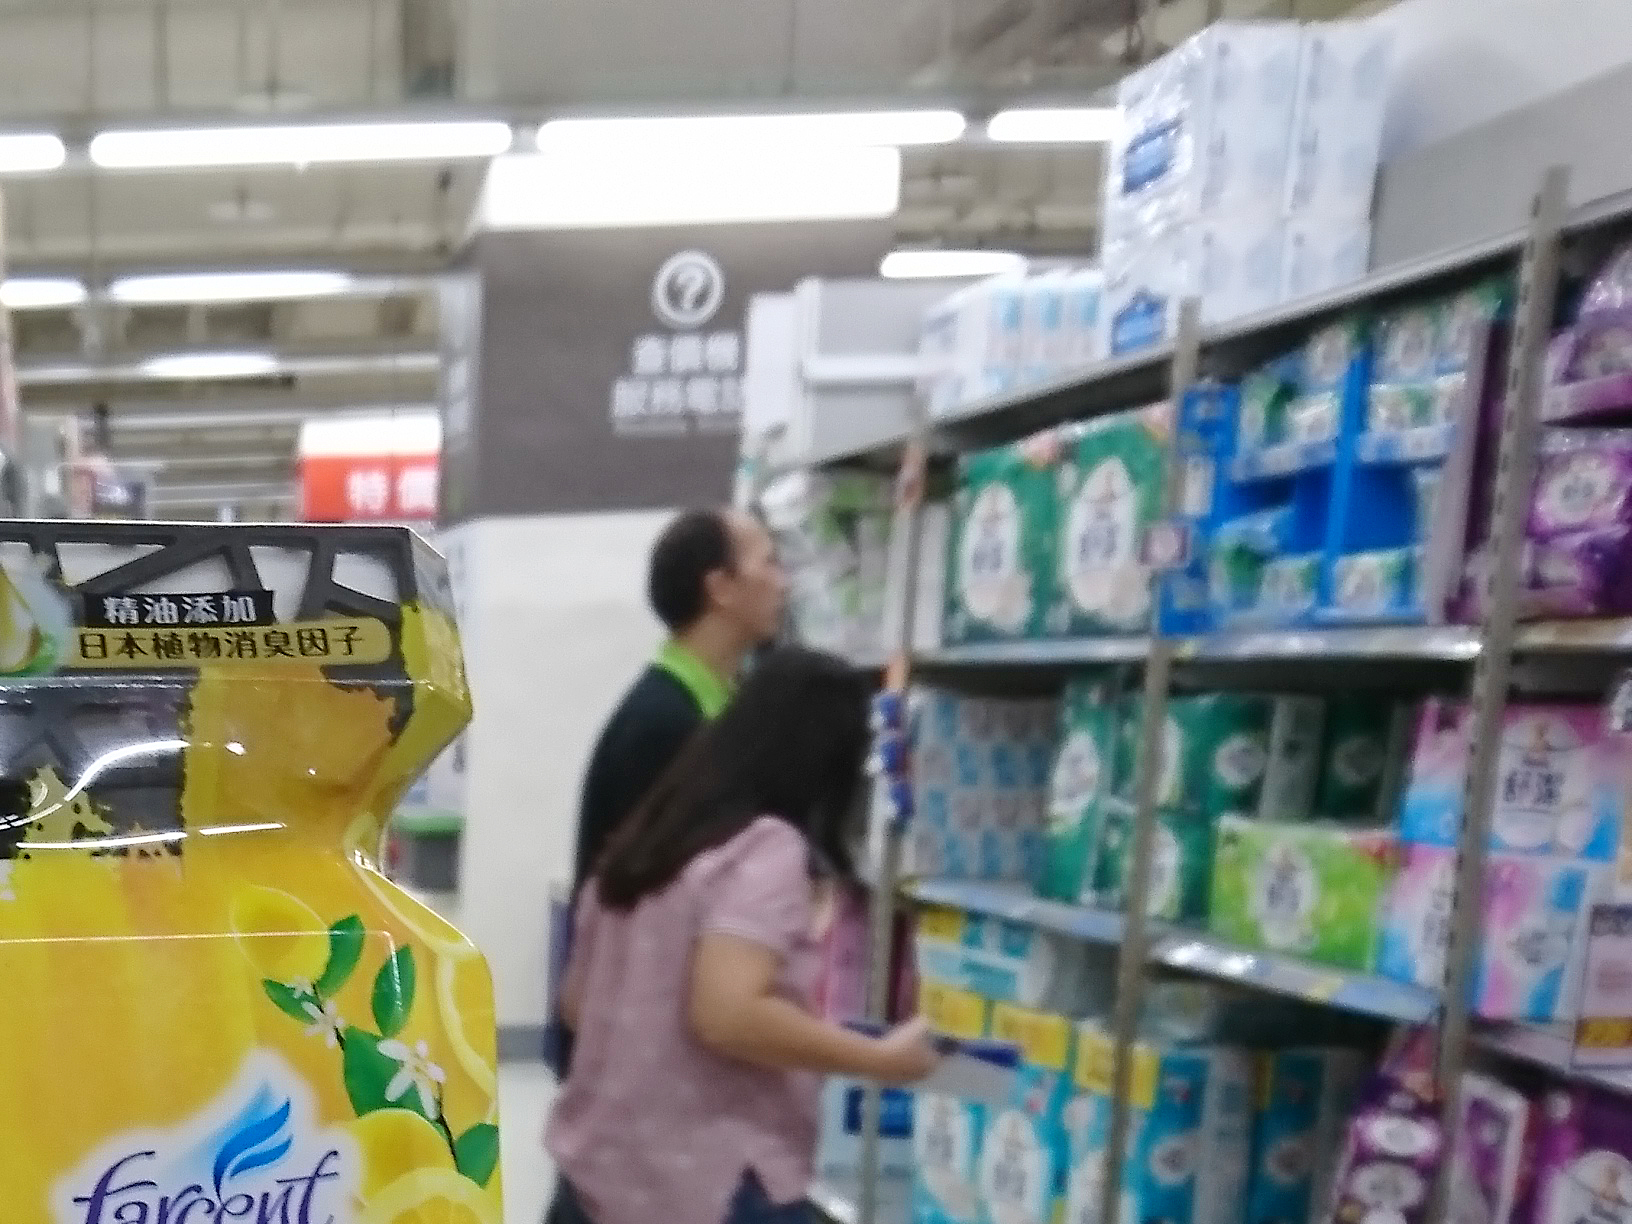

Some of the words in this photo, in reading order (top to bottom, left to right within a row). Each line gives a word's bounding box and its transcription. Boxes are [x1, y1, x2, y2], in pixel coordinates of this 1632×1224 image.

[103, 594, 257, 625] 精油添加
[77, 622, 366, 661] 日本植物消臭因子
